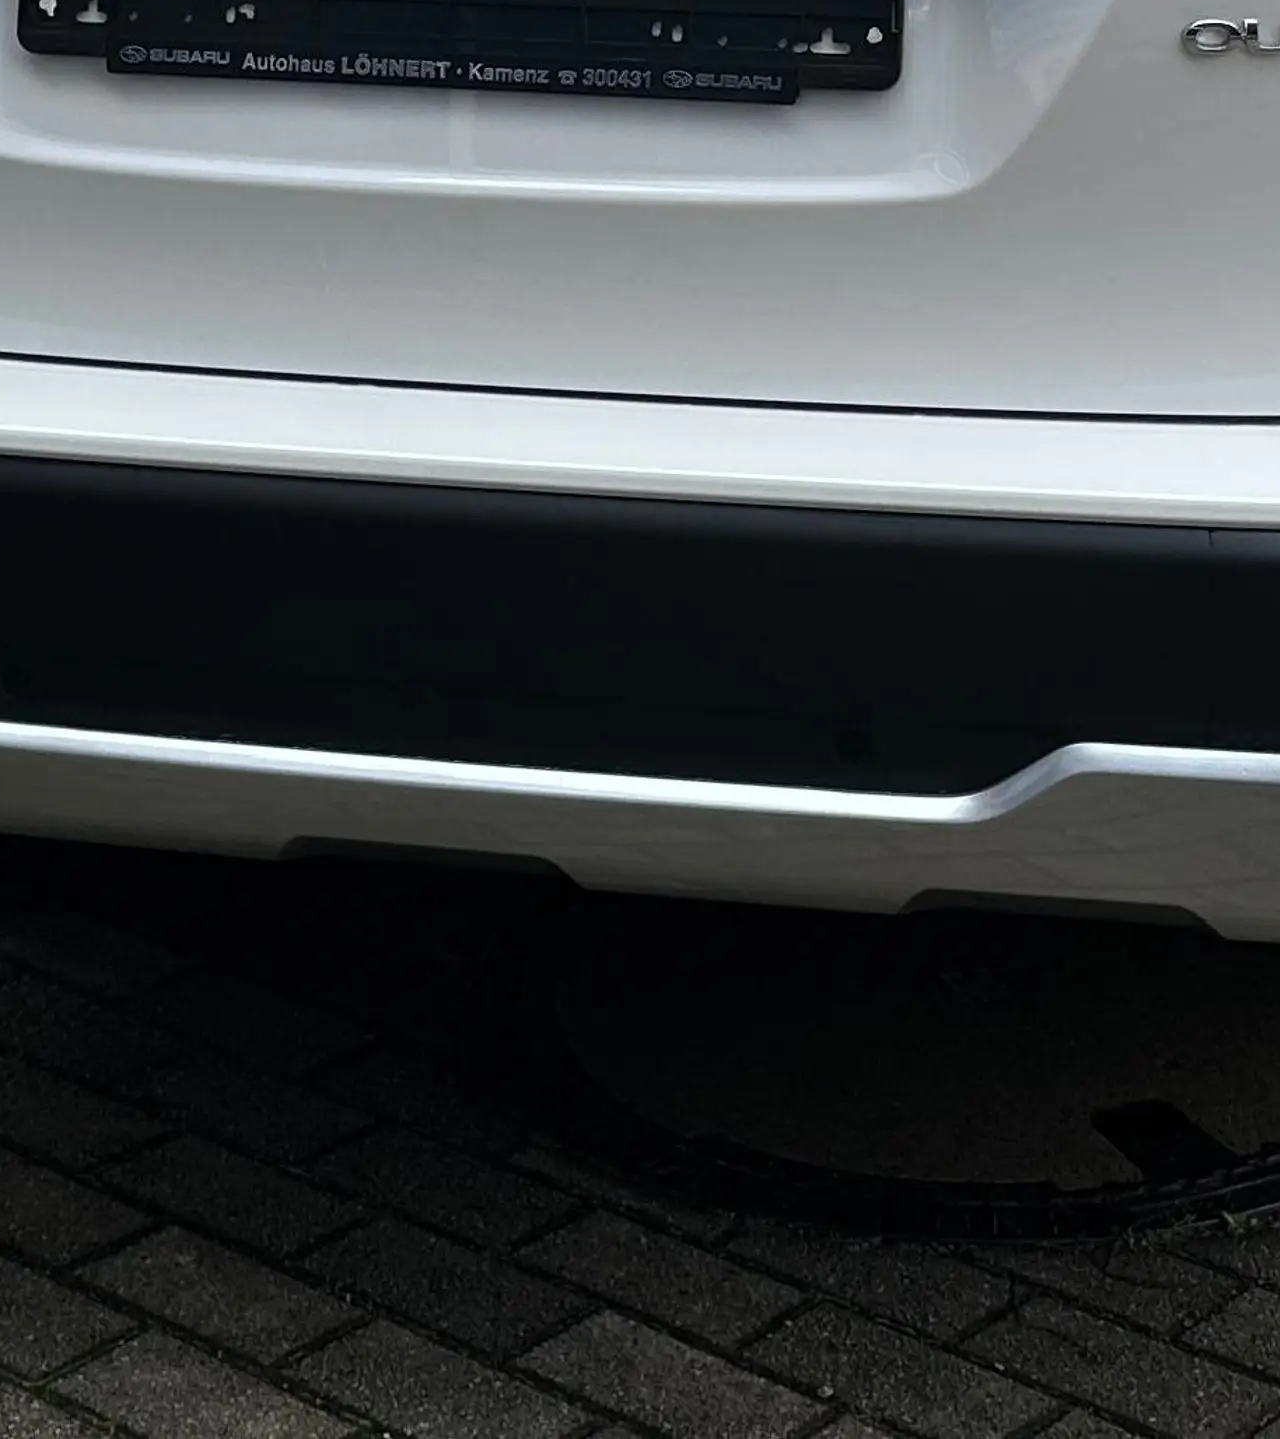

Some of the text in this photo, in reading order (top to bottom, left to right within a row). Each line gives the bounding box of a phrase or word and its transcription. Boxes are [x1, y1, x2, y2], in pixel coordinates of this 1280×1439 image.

[149, 48, 231, 65] SUBARU
[241, 52, 652, 88] Autohaus LÖHNERT Kamenz 300431
[695, 73, 783, 91] SUBARU
